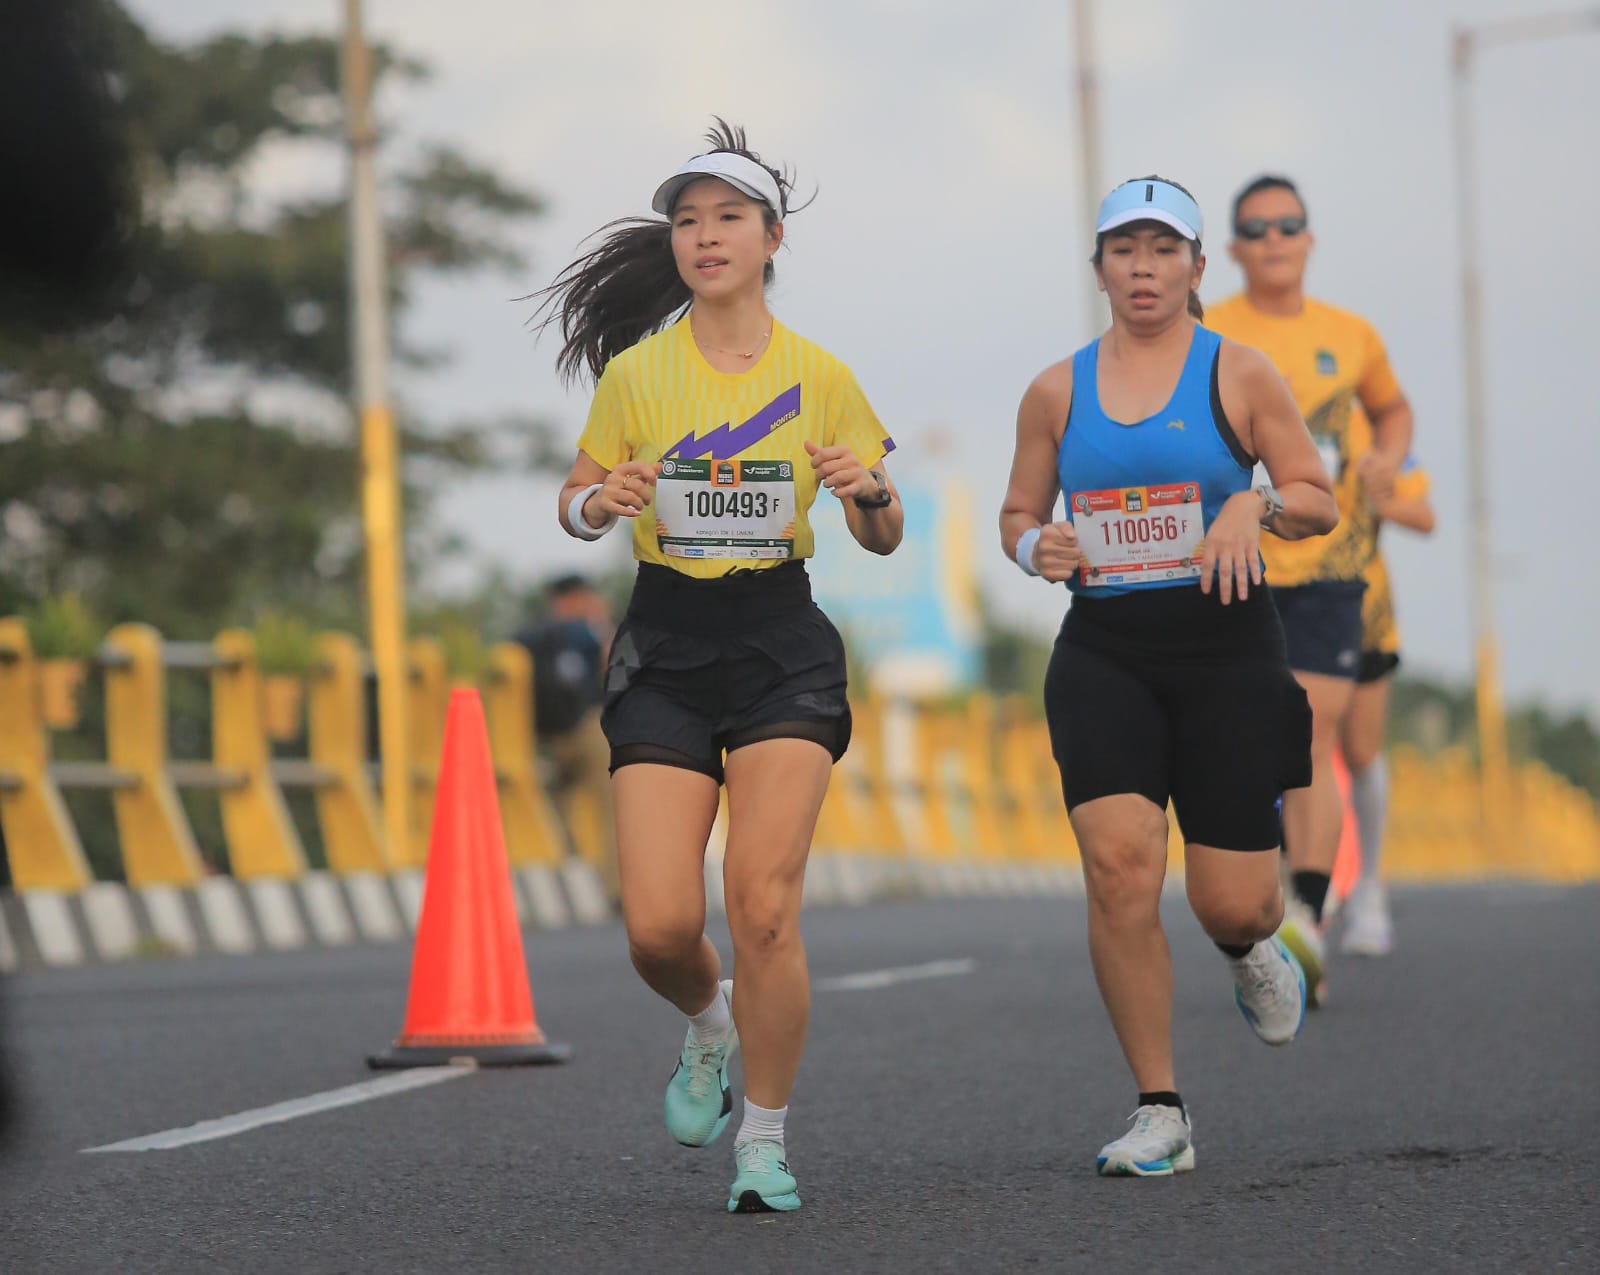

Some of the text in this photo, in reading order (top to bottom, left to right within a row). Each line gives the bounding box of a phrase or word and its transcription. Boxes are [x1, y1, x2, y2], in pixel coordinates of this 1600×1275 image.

[685, 491, 780, 518] 100493 F
[1101, 516, 1188, 545] 110056 F
